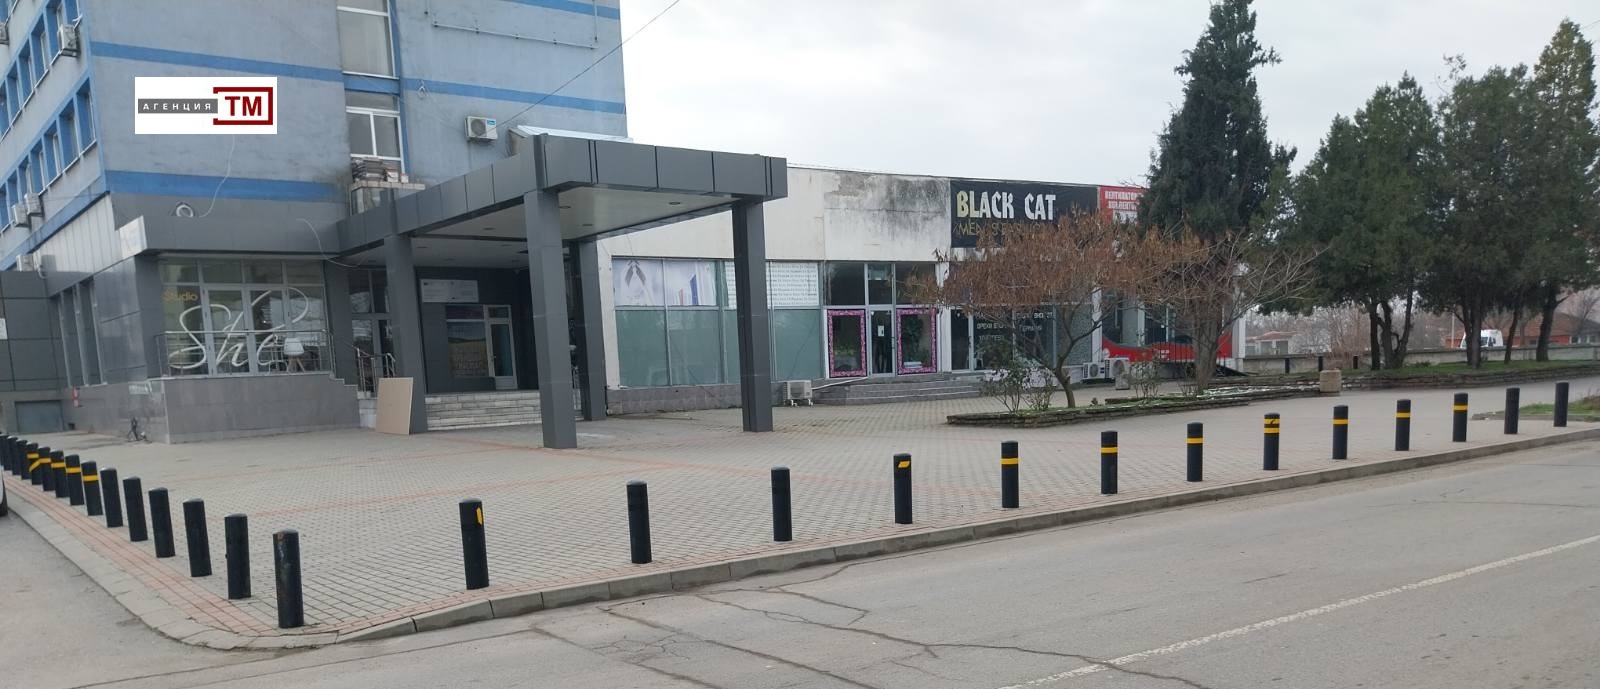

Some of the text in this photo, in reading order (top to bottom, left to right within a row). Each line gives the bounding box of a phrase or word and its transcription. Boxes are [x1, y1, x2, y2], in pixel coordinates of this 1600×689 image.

[957, 190, 1056, 220] BLACK CAT
[168, 287, 310, 369] She
